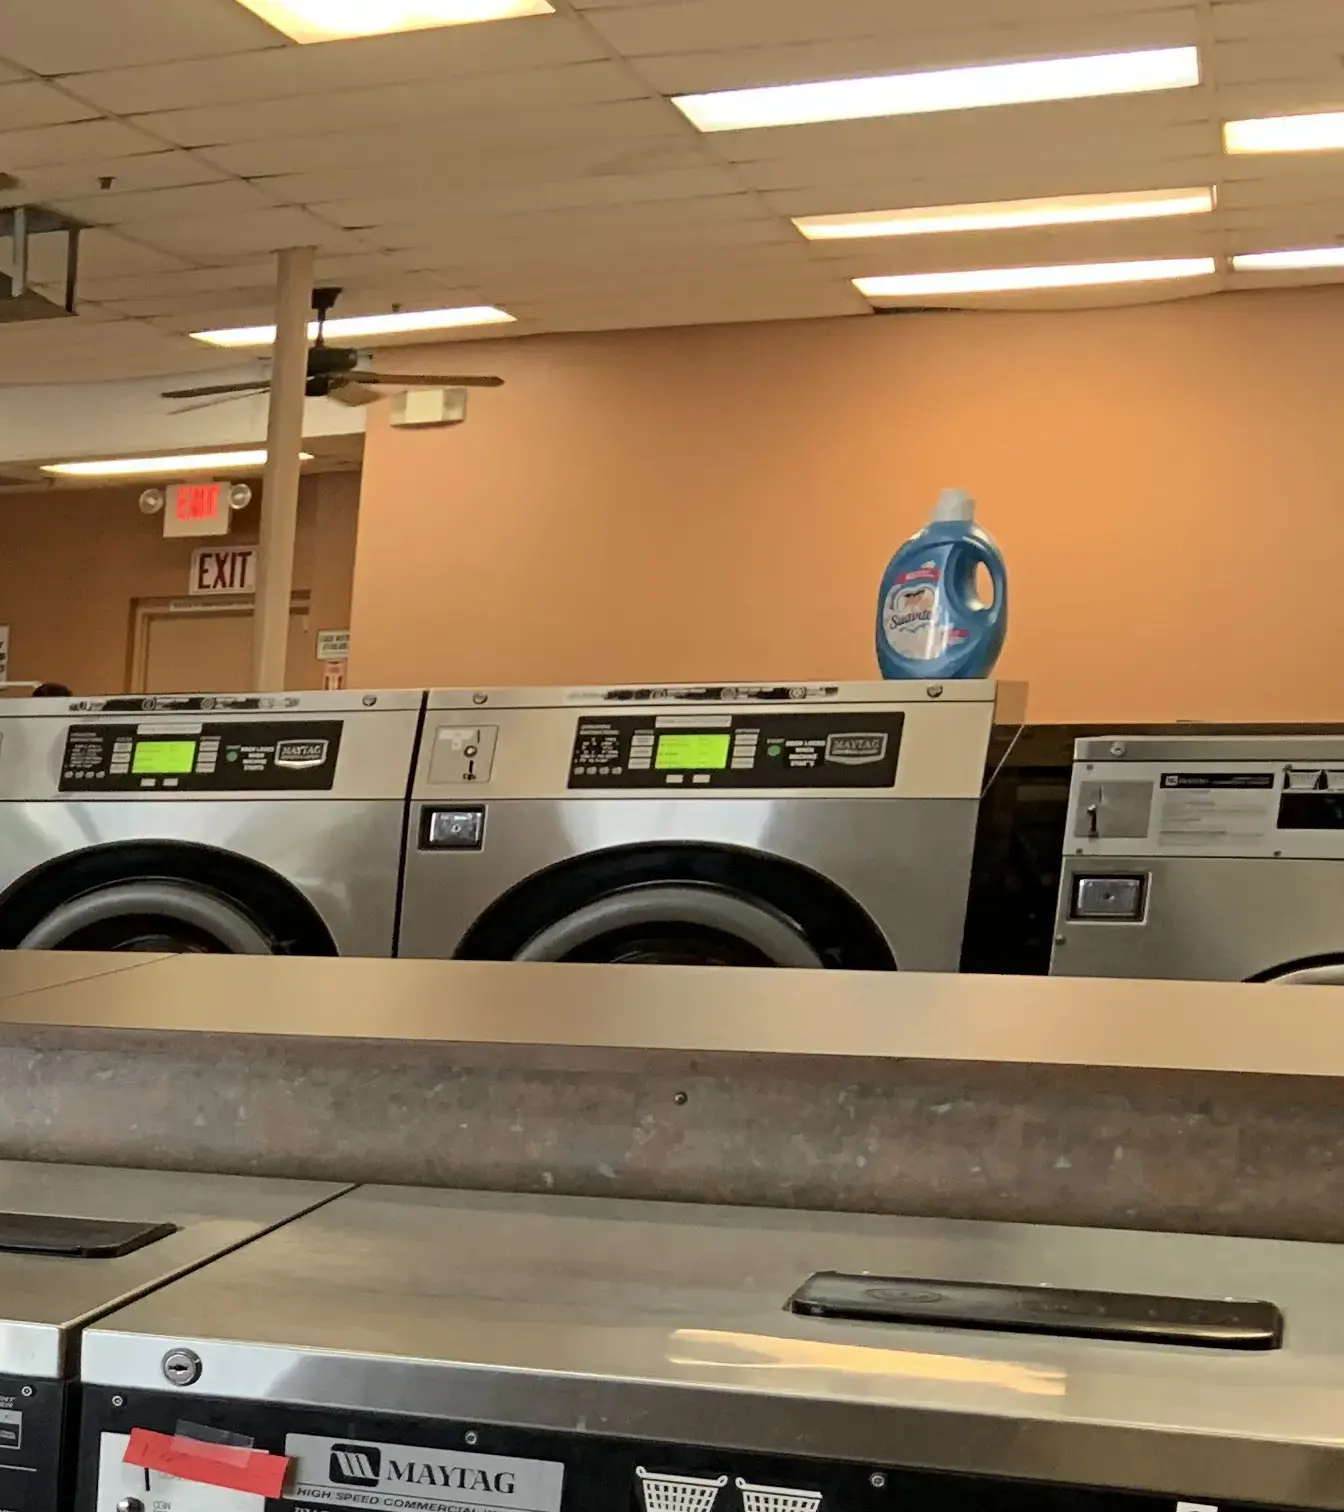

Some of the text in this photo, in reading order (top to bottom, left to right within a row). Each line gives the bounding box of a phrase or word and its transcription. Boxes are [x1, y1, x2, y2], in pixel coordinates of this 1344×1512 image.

[177, 483, 221, 520] EXIT
[198, 551, 252, 589] EXIT
[282, 745, 321, 755] MAYTAG
[833, 740, 880, 749] MAYTAG
[386, 1460, 516, 1495] MAYTAG
[296, 1487, 331, 1499] HIGH
[336, 1492, 379, 1505] SPEED
